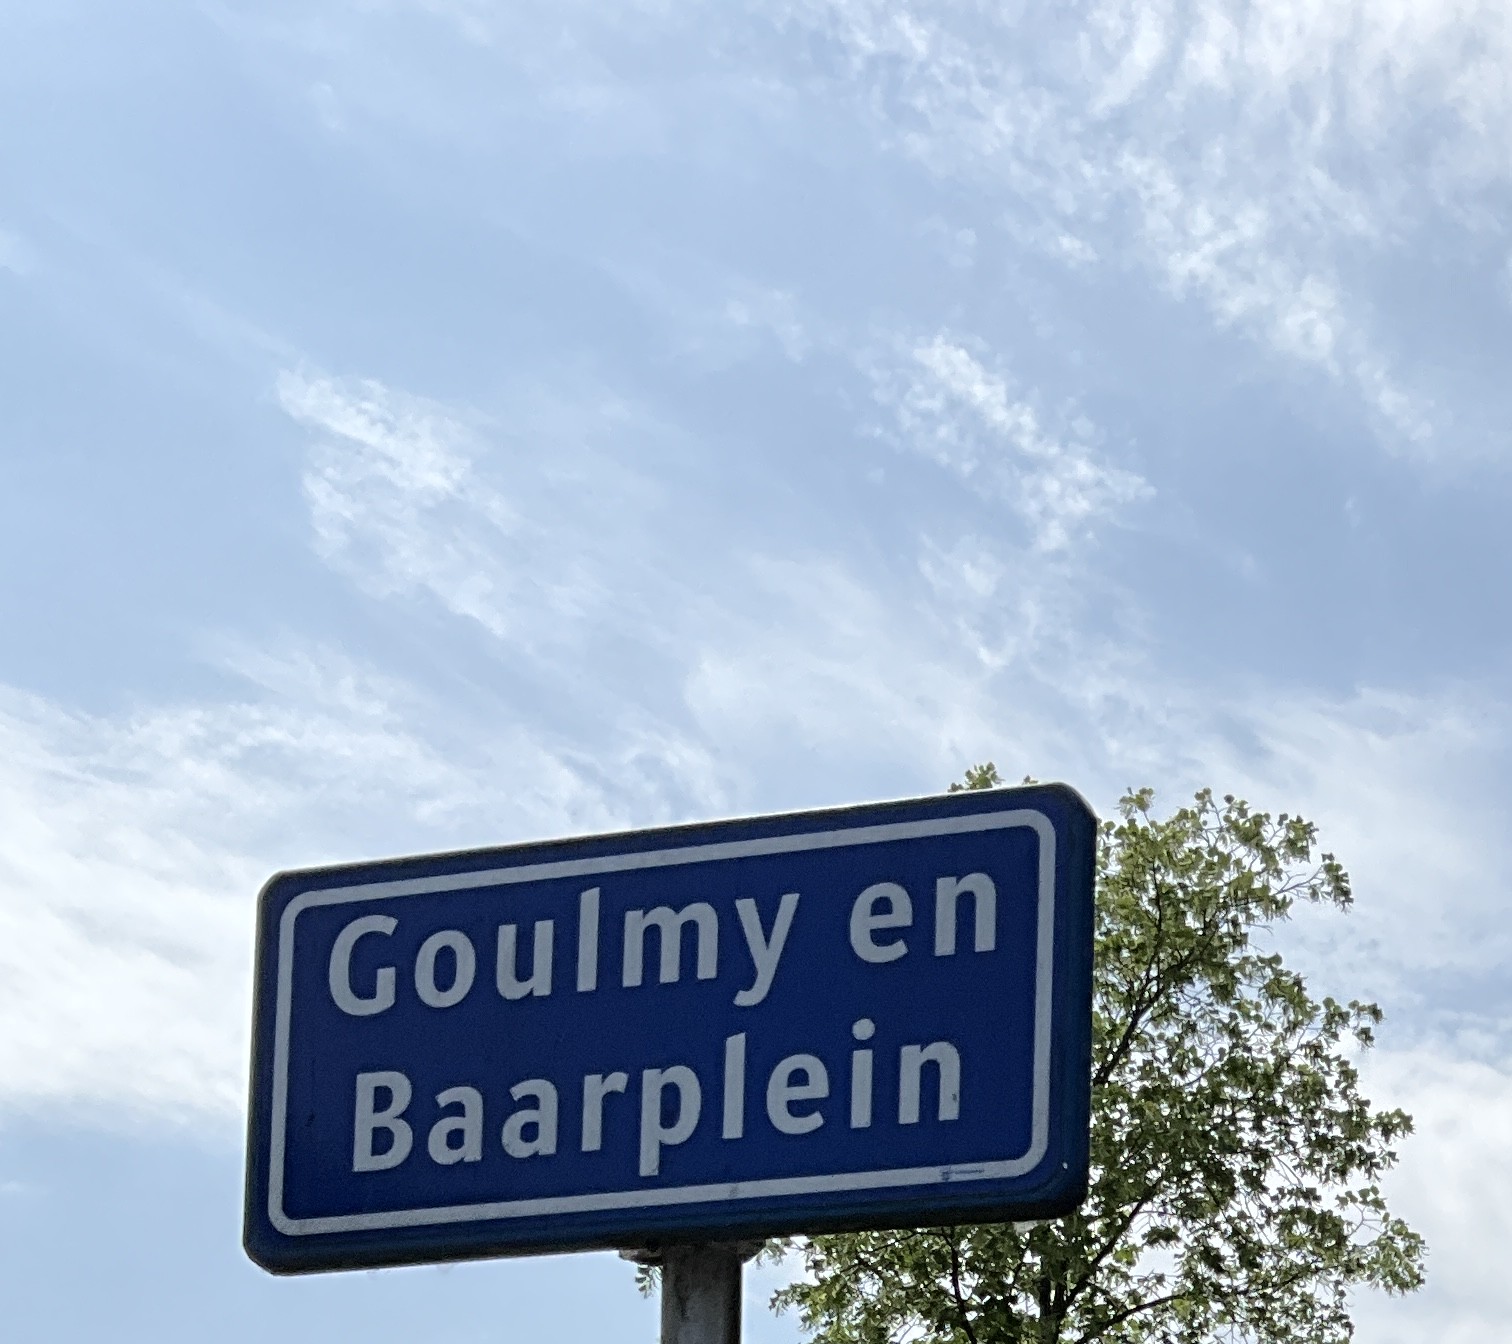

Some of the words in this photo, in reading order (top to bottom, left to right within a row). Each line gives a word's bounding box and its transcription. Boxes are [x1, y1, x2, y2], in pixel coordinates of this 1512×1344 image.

[328, 886, 800, 1016] Goulmy
[849, 870, 998, 963] en
[351, 1018, 962, 1177] Baarplein
